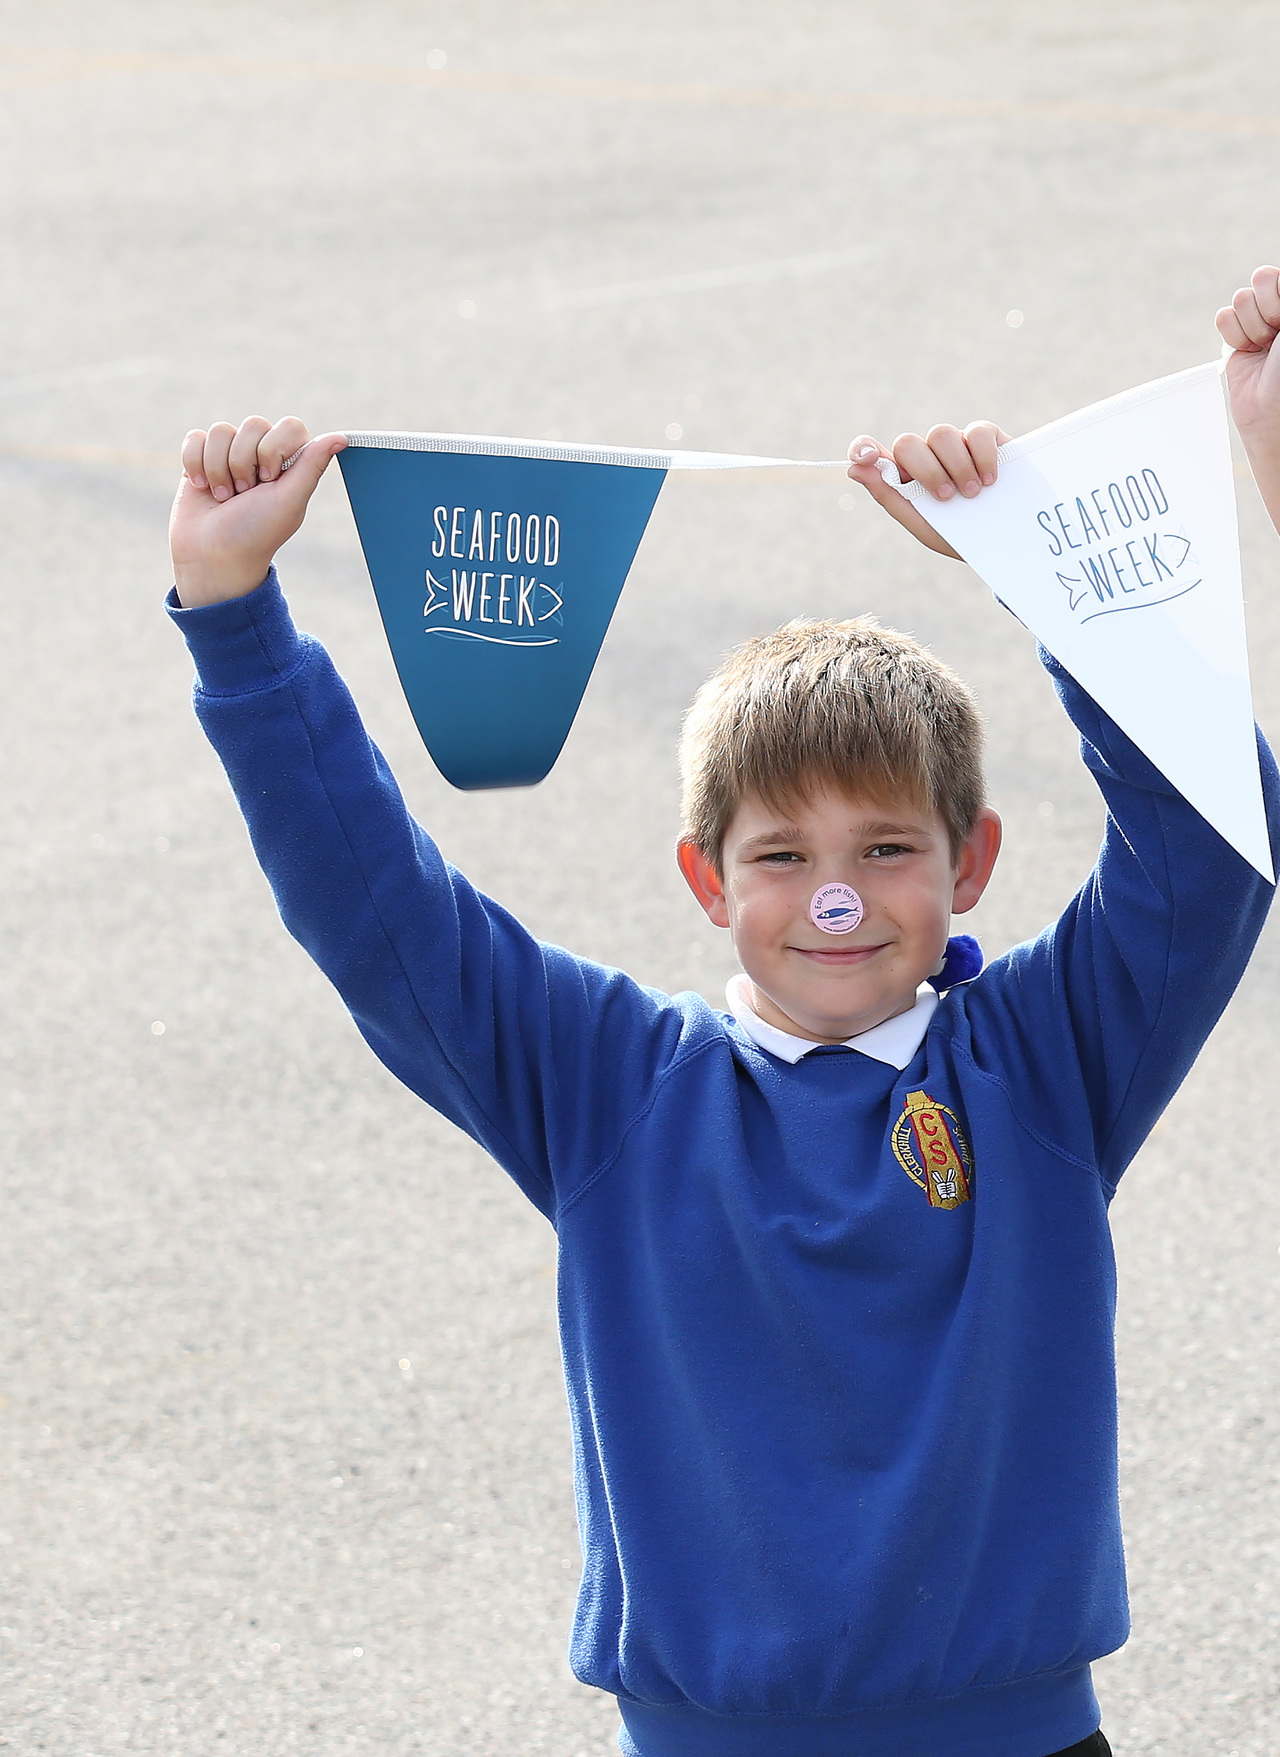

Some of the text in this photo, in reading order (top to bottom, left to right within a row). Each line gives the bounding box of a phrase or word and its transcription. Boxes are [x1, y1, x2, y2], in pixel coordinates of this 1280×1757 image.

[431, 505, 561, 567] SEAFOOD
[1036, 468, 1169, 556] SEAFOOD
[451, 568, 536, 628] WEEK
[1078, 532, 1175, 603] WEEK
[814, 896, 824, 909] Eat
[821, 887, 842, 899] more
[897, 1127, 924, 1177] CLERKHILL
